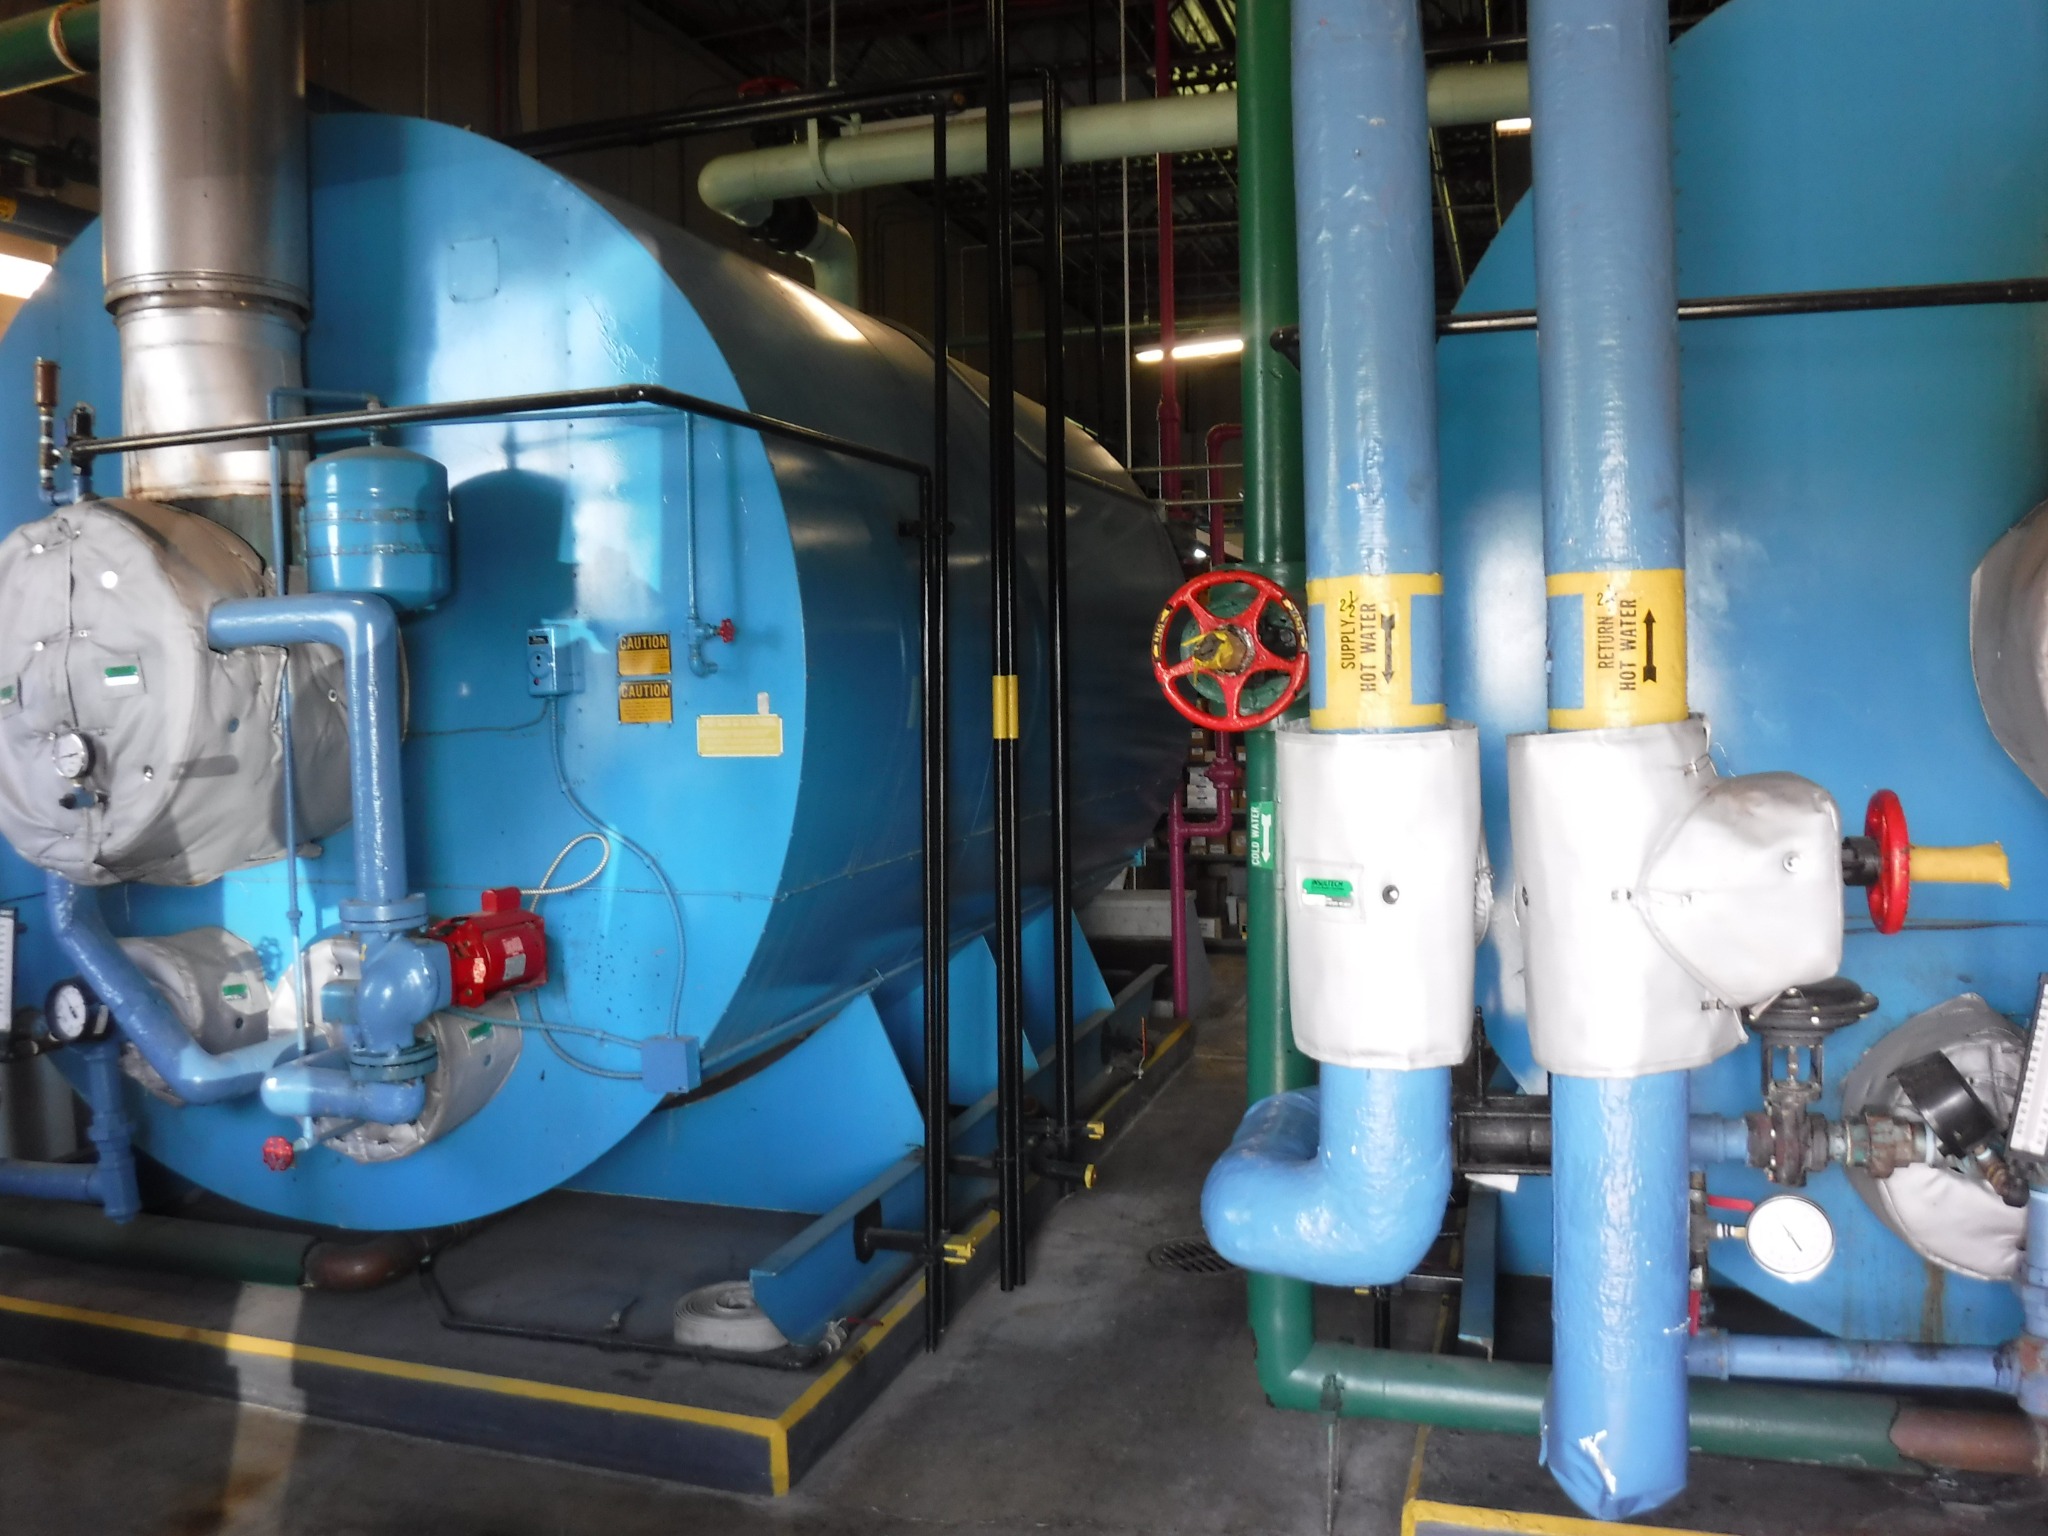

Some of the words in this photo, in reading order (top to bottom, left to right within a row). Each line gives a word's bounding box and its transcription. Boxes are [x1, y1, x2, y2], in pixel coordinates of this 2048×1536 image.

[1360, 603, 1377, 654] WATER
[1620, 599, 1637, 651] WATER
[620, 635, 667, 650] CAUTION
[1341, 619, 1356, 670] SUPPLY
[1597, 615, 1615, 669] RETURN
[621, 683, 669, 698] CAUTION
[1360, 662, 1377, 692] HOT
[1620, 662, 1637, 691] HOT
[1250, 806, 1260, 838] WATER
[1251, 842, 1260, 866] COLD
